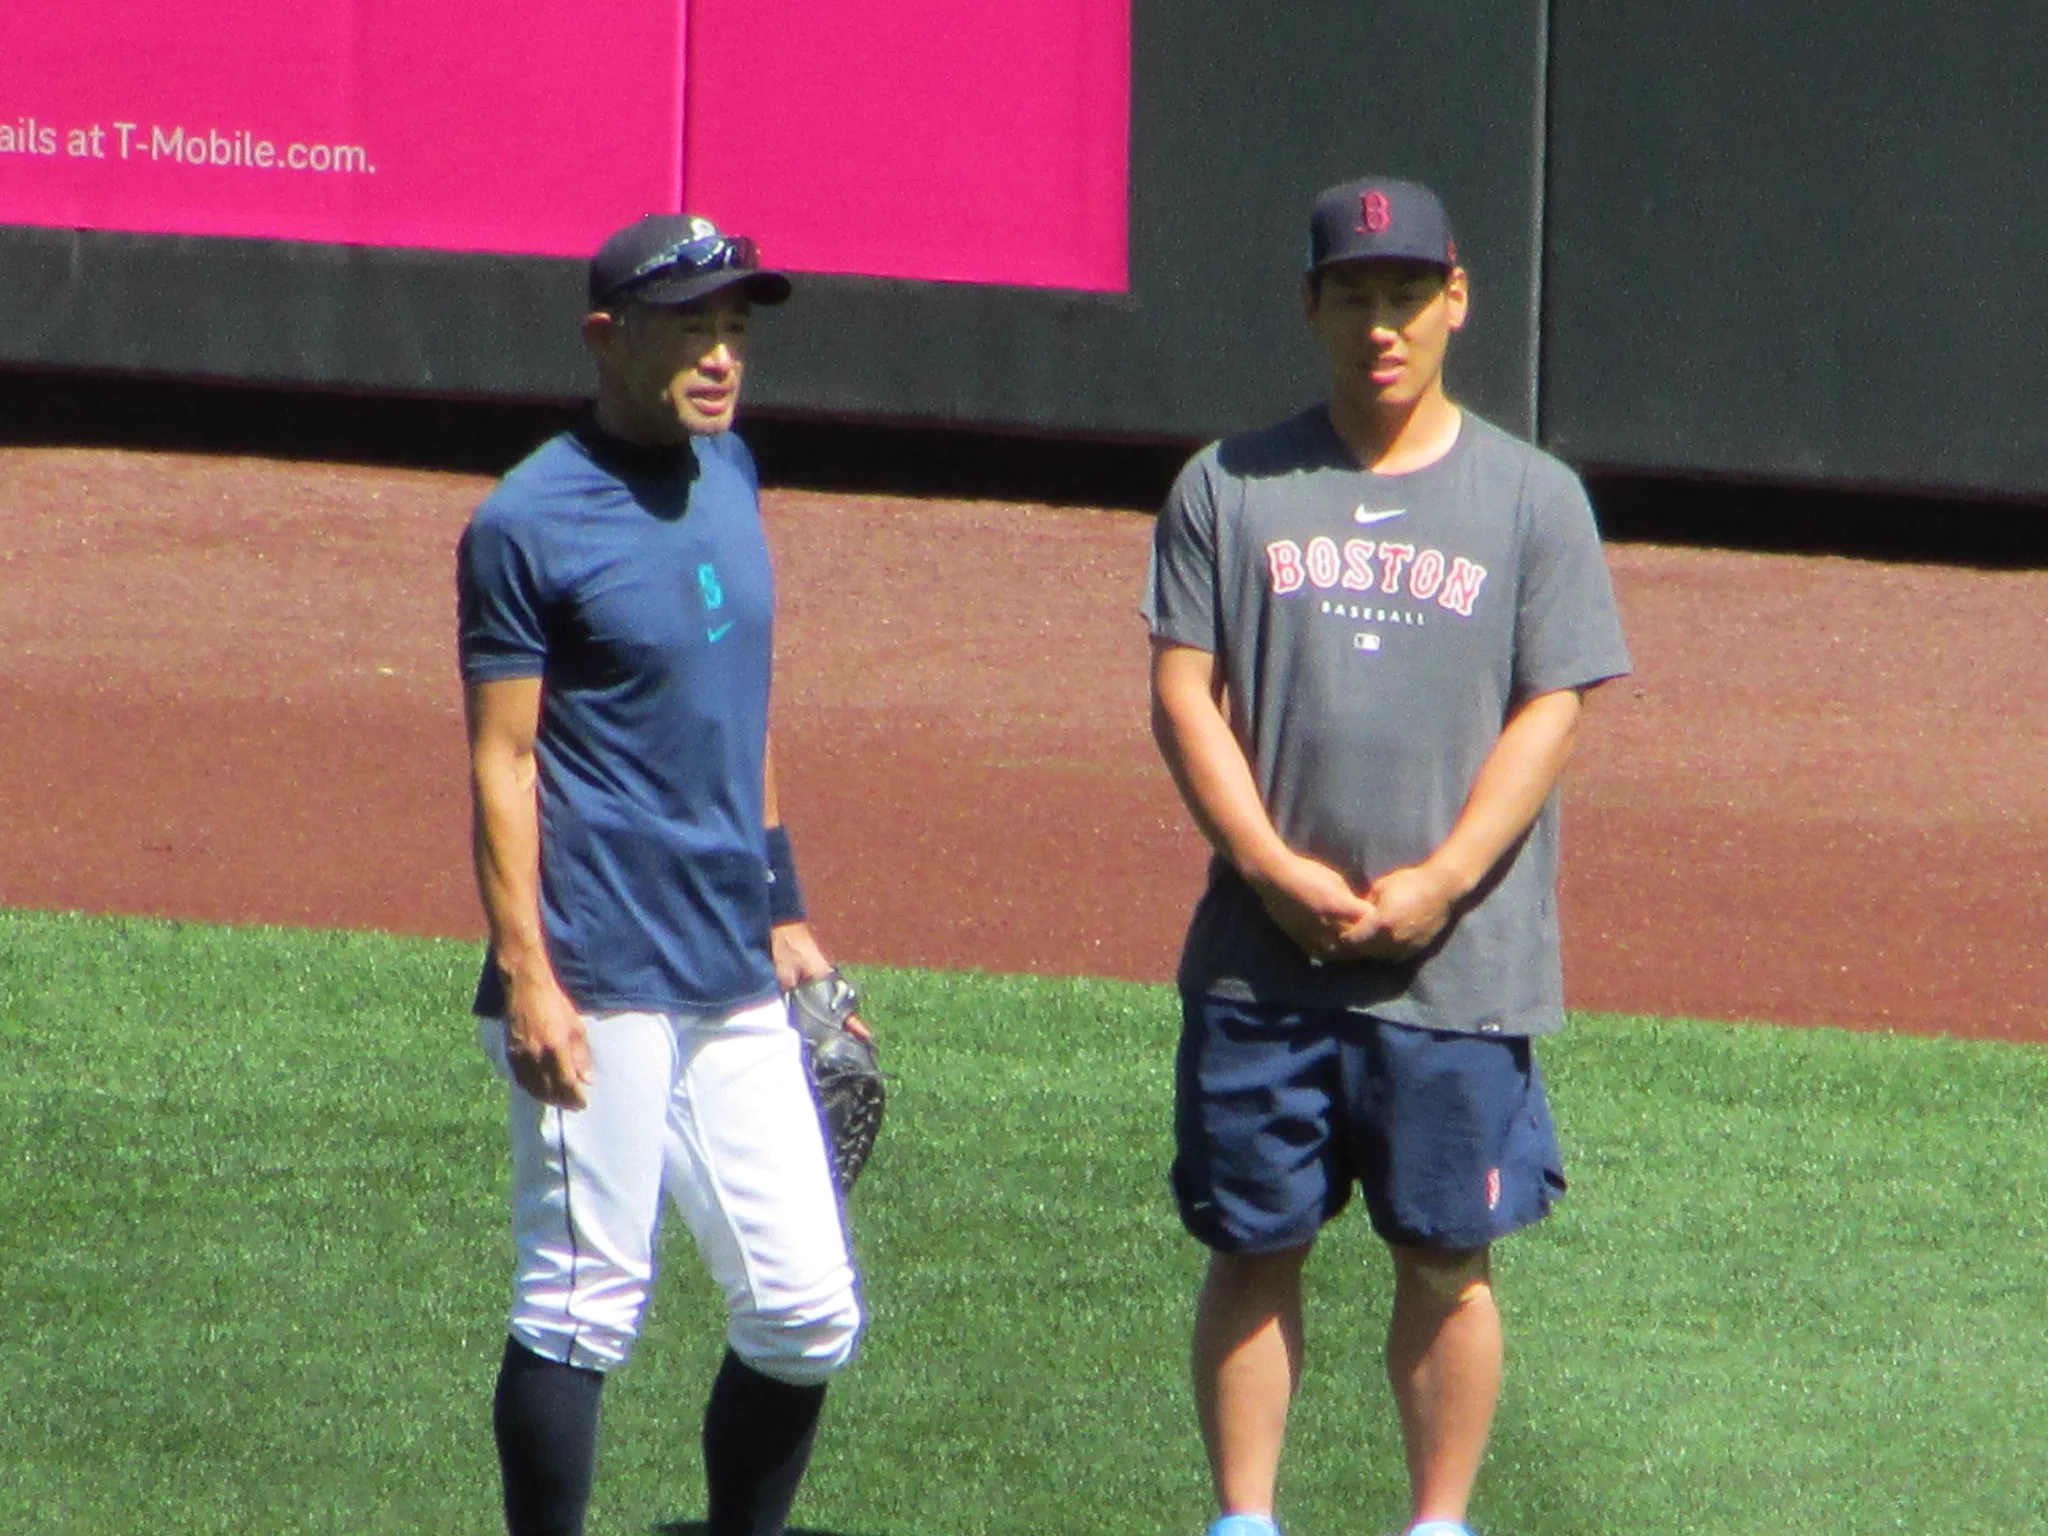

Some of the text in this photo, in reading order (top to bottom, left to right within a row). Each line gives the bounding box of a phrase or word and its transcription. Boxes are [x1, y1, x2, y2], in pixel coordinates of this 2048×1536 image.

[0, 117, 376, 174] ails at T-Mobile.com.
[1354, 188, 1392, 235] B
[1267, 536, 1487, 616] BOSTON
[1321, 600, 1425, 626] BASEBALL
